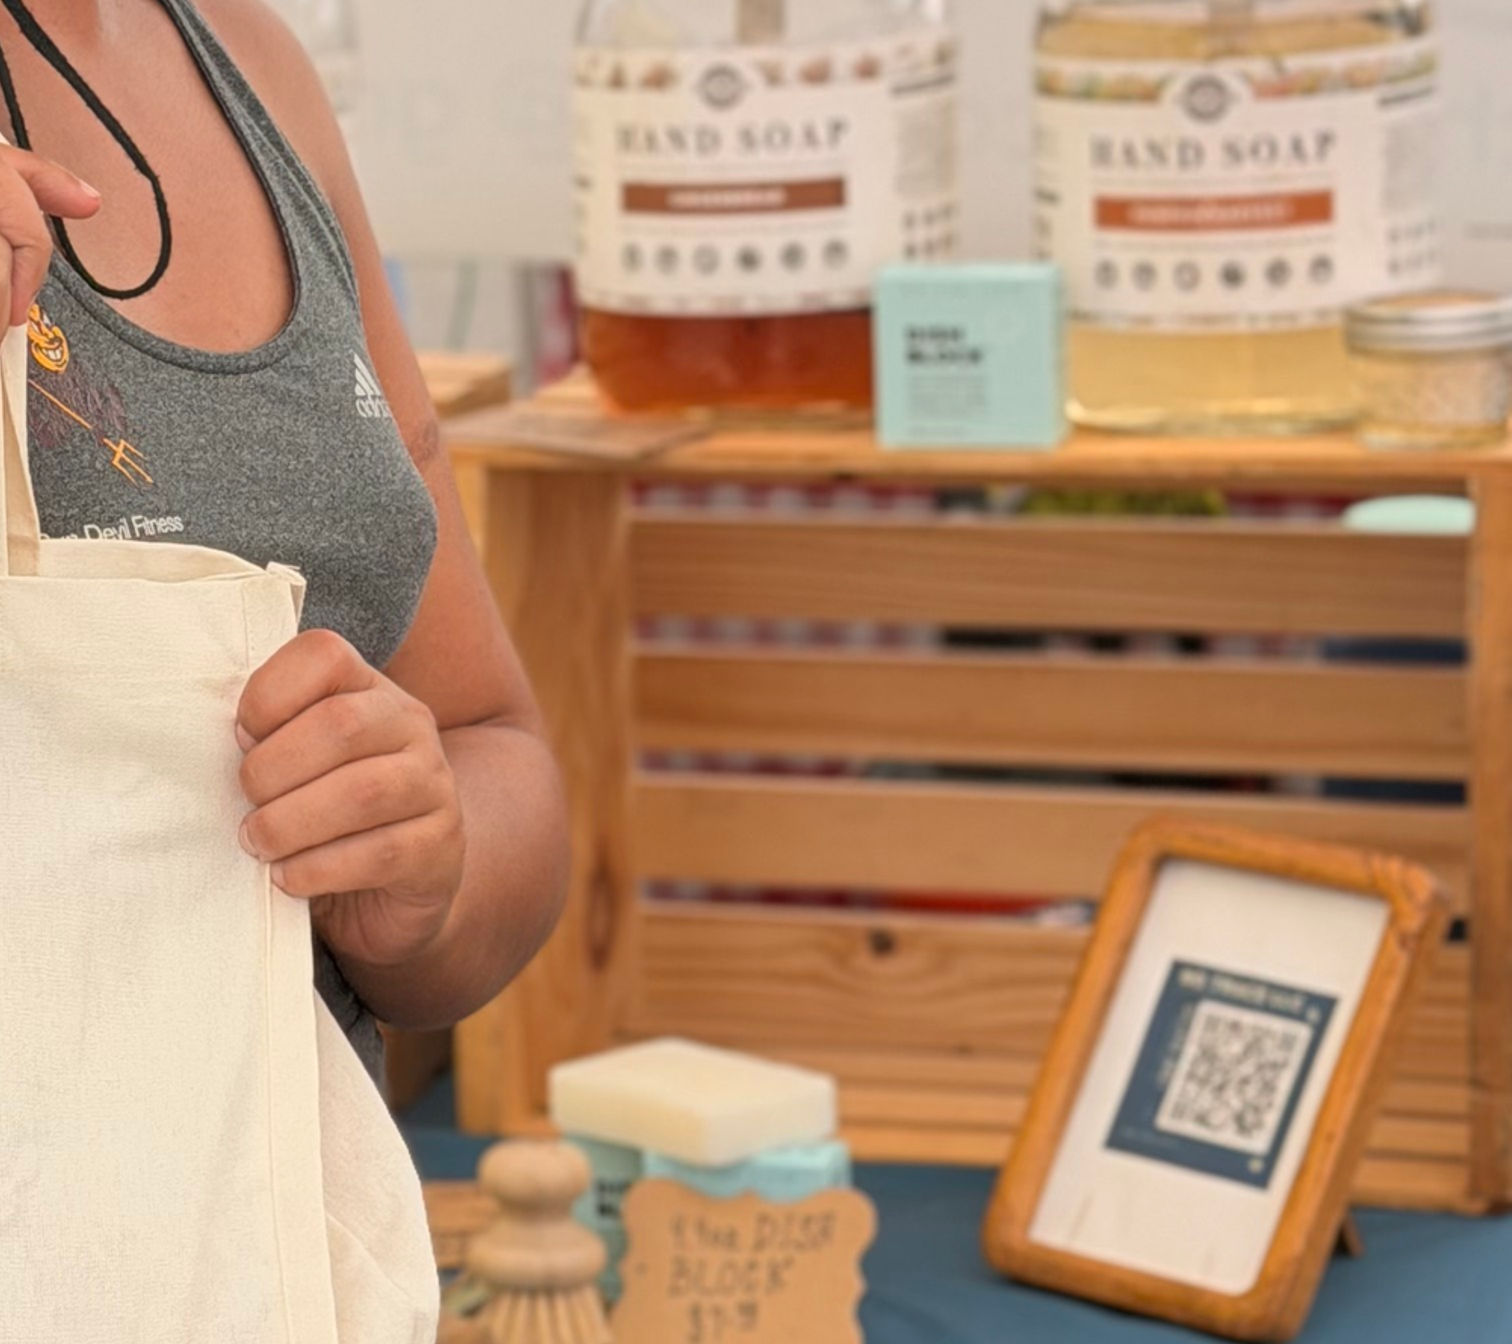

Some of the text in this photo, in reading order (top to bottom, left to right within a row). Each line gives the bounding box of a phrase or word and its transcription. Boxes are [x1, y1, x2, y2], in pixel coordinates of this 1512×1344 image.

[616, 118, 848, 155] HAND SOAP
[1091, 129, 1336, 170] HAND SOAP
[84, 515, 185, 541] Devil Fitness
